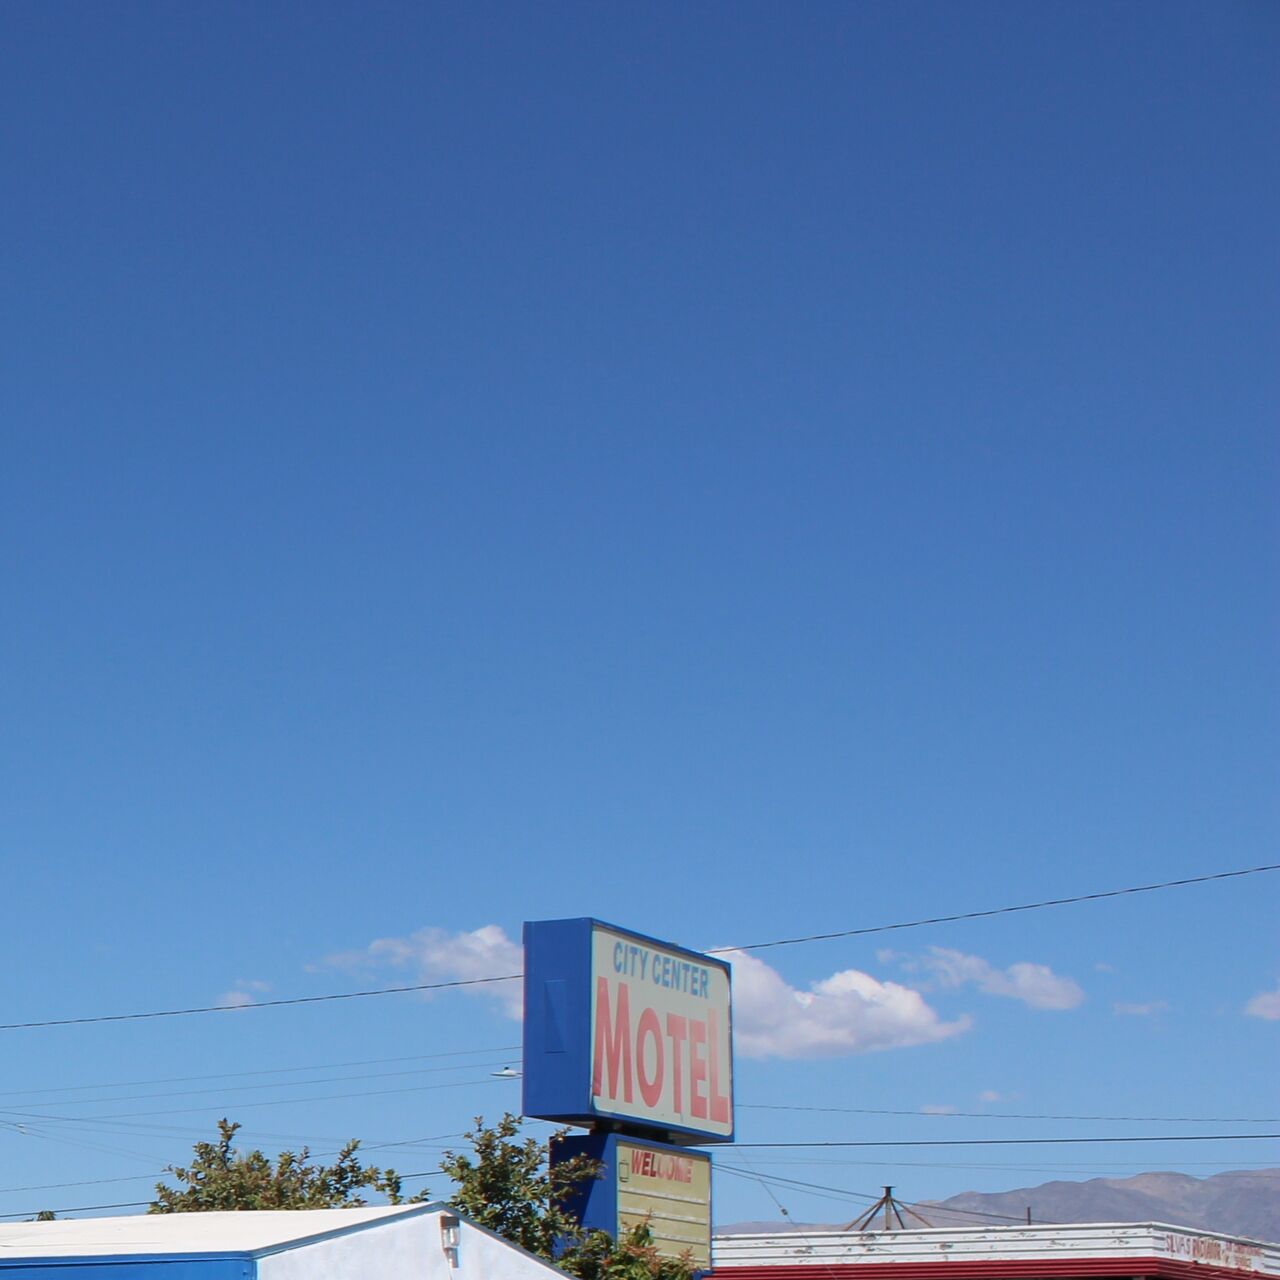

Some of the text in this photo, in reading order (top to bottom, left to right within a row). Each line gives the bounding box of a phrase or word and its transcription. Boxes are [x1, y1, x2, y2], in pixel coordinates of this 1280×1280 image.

[612, 941, 710, 999] CITY CENTER
[592, 976, 729, 1124] MOTEL
[630, 1149, 694, 1184] WELCOME
